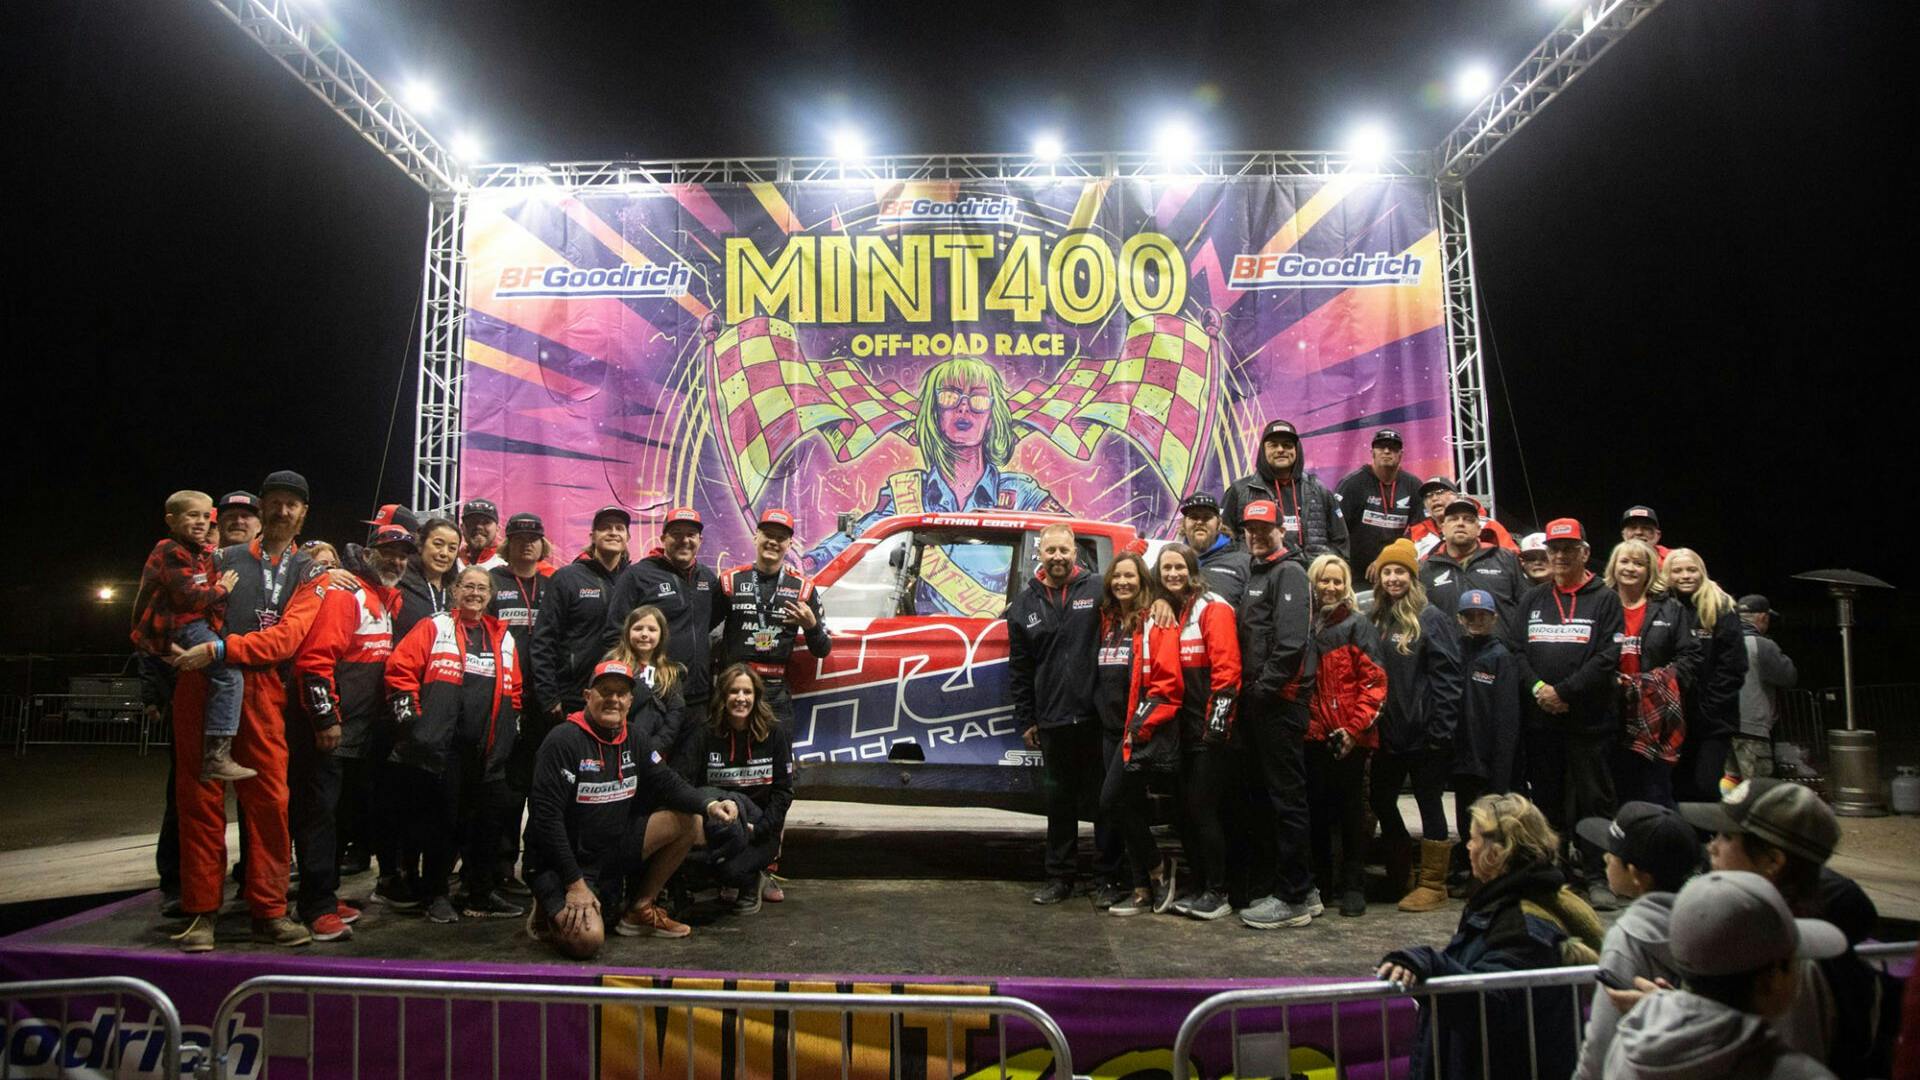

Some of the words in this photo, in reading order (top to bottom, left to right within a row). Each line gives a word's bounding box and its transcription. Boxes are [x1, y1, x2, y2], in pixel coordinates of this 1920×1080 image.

[880, 199, 1014, 216] BFGoodrich
[499, 263, 688, 288] BFGoodrich
[1232, 254, 1421, 279] BFGoodrich
[851, 333, 984, 357] OFF-ROAD
[995, 333, 1065, 356] RACE
[933, 517, 980, 526] ETHAN
[981, 519, 1028, 528] EBERT
